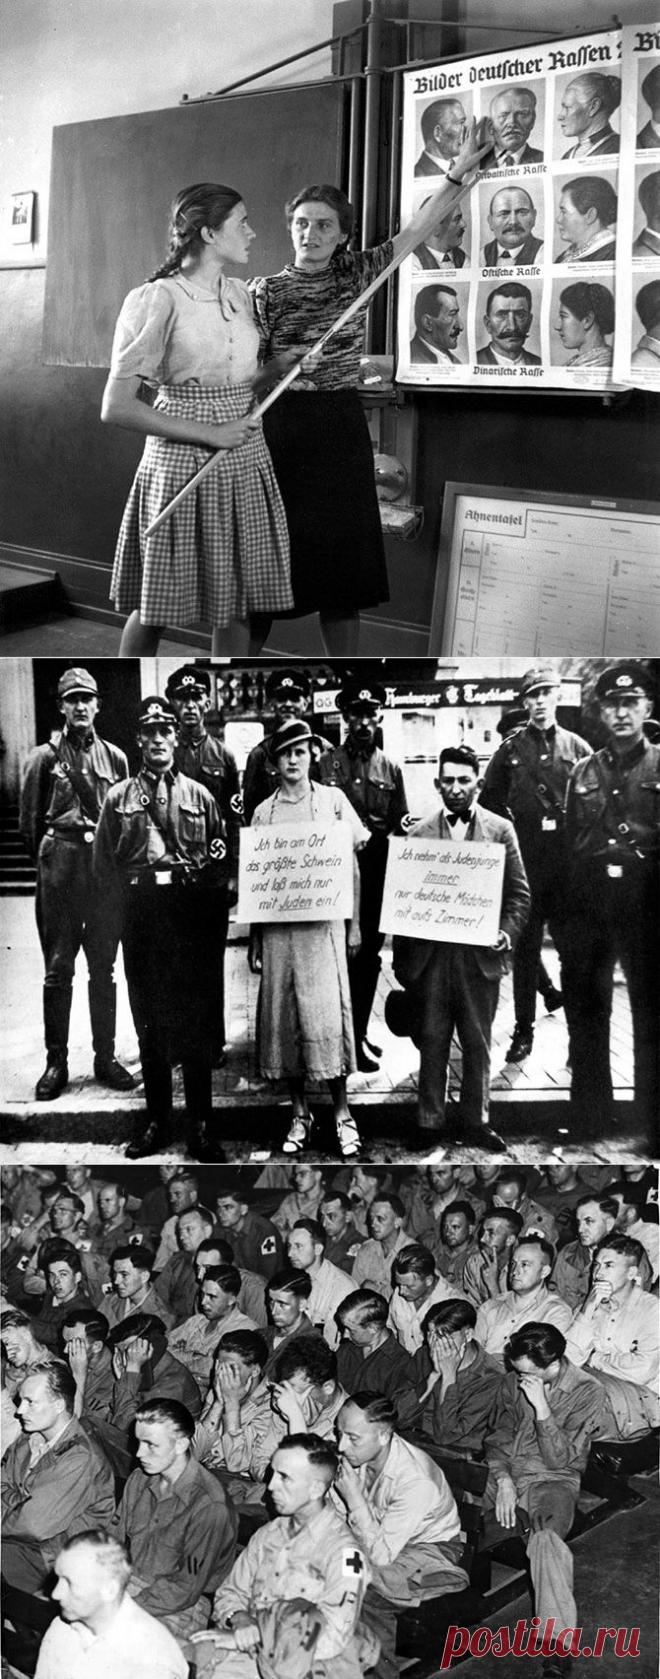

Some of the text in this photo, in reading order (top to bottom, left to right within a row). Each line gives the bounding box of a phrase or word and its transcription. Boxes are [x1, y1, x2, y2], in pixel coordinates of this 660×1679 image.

[413, 73, 462, 94] Bilder
[469, 57, 543, 84] deutscher
[548, 44, 612, 71] Rassen
[523, 164, 547, 175] Rasse
[481, 266, 541, 278] Ostische Rasse
[473, 366, 544, 377] Dinarische Rasse
[464, 509, 523, 526] Ahnentafel
[384, 687, 441, 708] Hamburger
[254, 833, 326, 852] Ich bin am Ort
[246, 853, 342, 875] das größte Schwein
[398, 848, 413, 861] Ich
[440, 852, 452, 864] als
[452, 851, 500, 870] Judenjunge
[252, 878, 270, 893] und
[289, 874, 312, 890] mich
[314, 878, 332, 889] nur
[424, 870, 460, 884] immer
[258, 891, 341, 910] mit Juden ein!
[394, 888, 493, 908] nur deutsche Mädchen
[394, 905, 412, 919] mit
[411, 908, 432, 922] aufs
